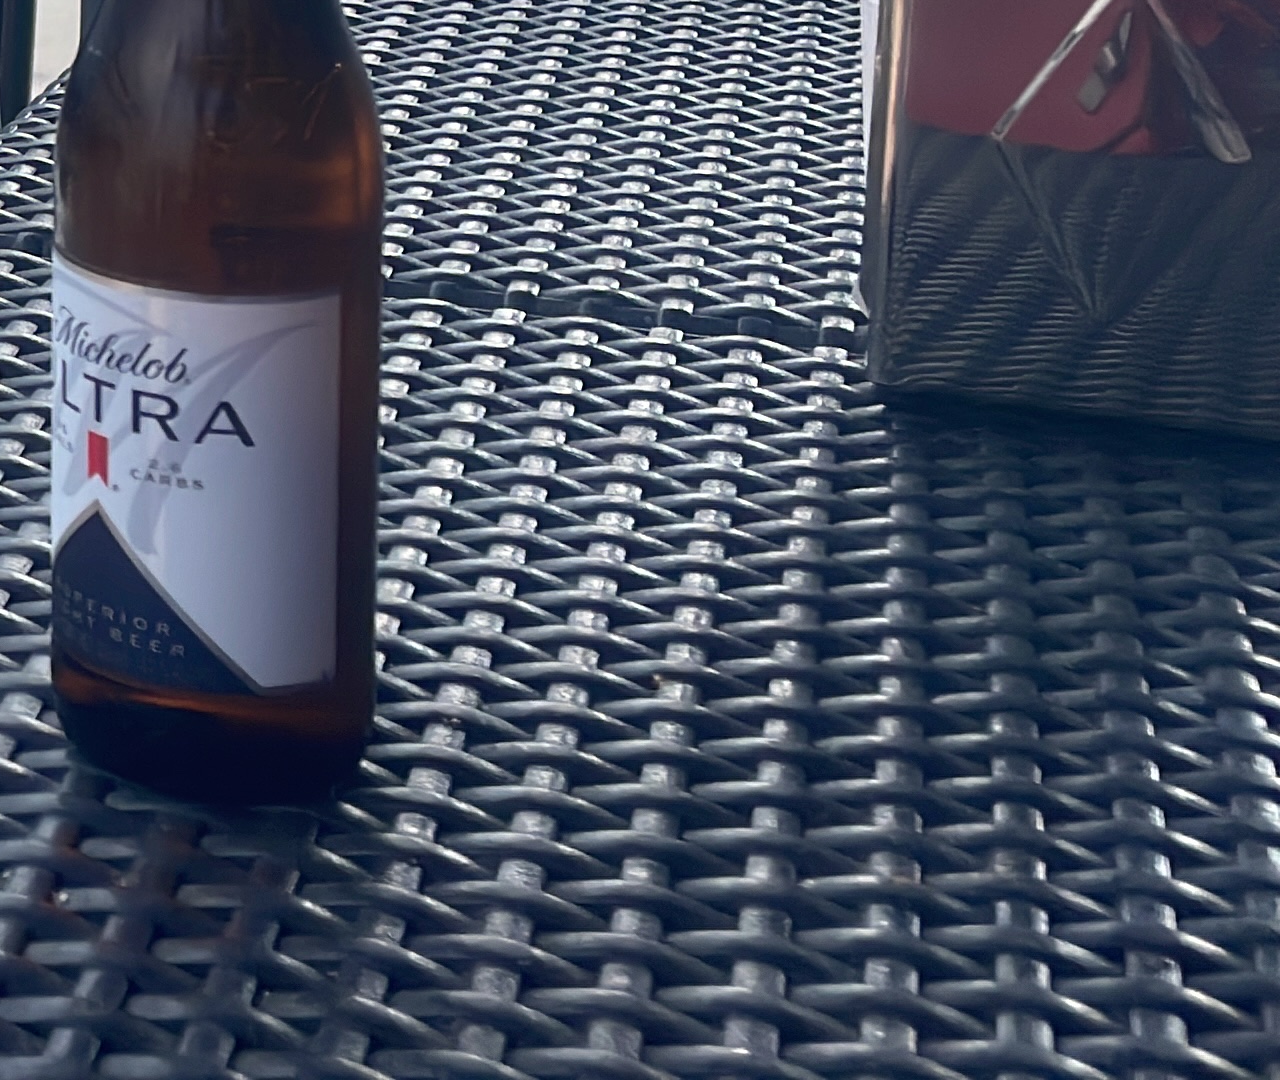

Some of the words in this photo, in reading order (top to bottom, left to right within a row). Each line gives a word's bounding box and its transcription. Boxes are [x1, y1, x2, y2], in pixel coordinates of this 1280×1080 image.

[55, 305, 188, 383] Michelob
[60, 359, 255, 448] LTRA
[129, 468, 205, 491] CARBS
[109, 627, 185, 658] BEER
